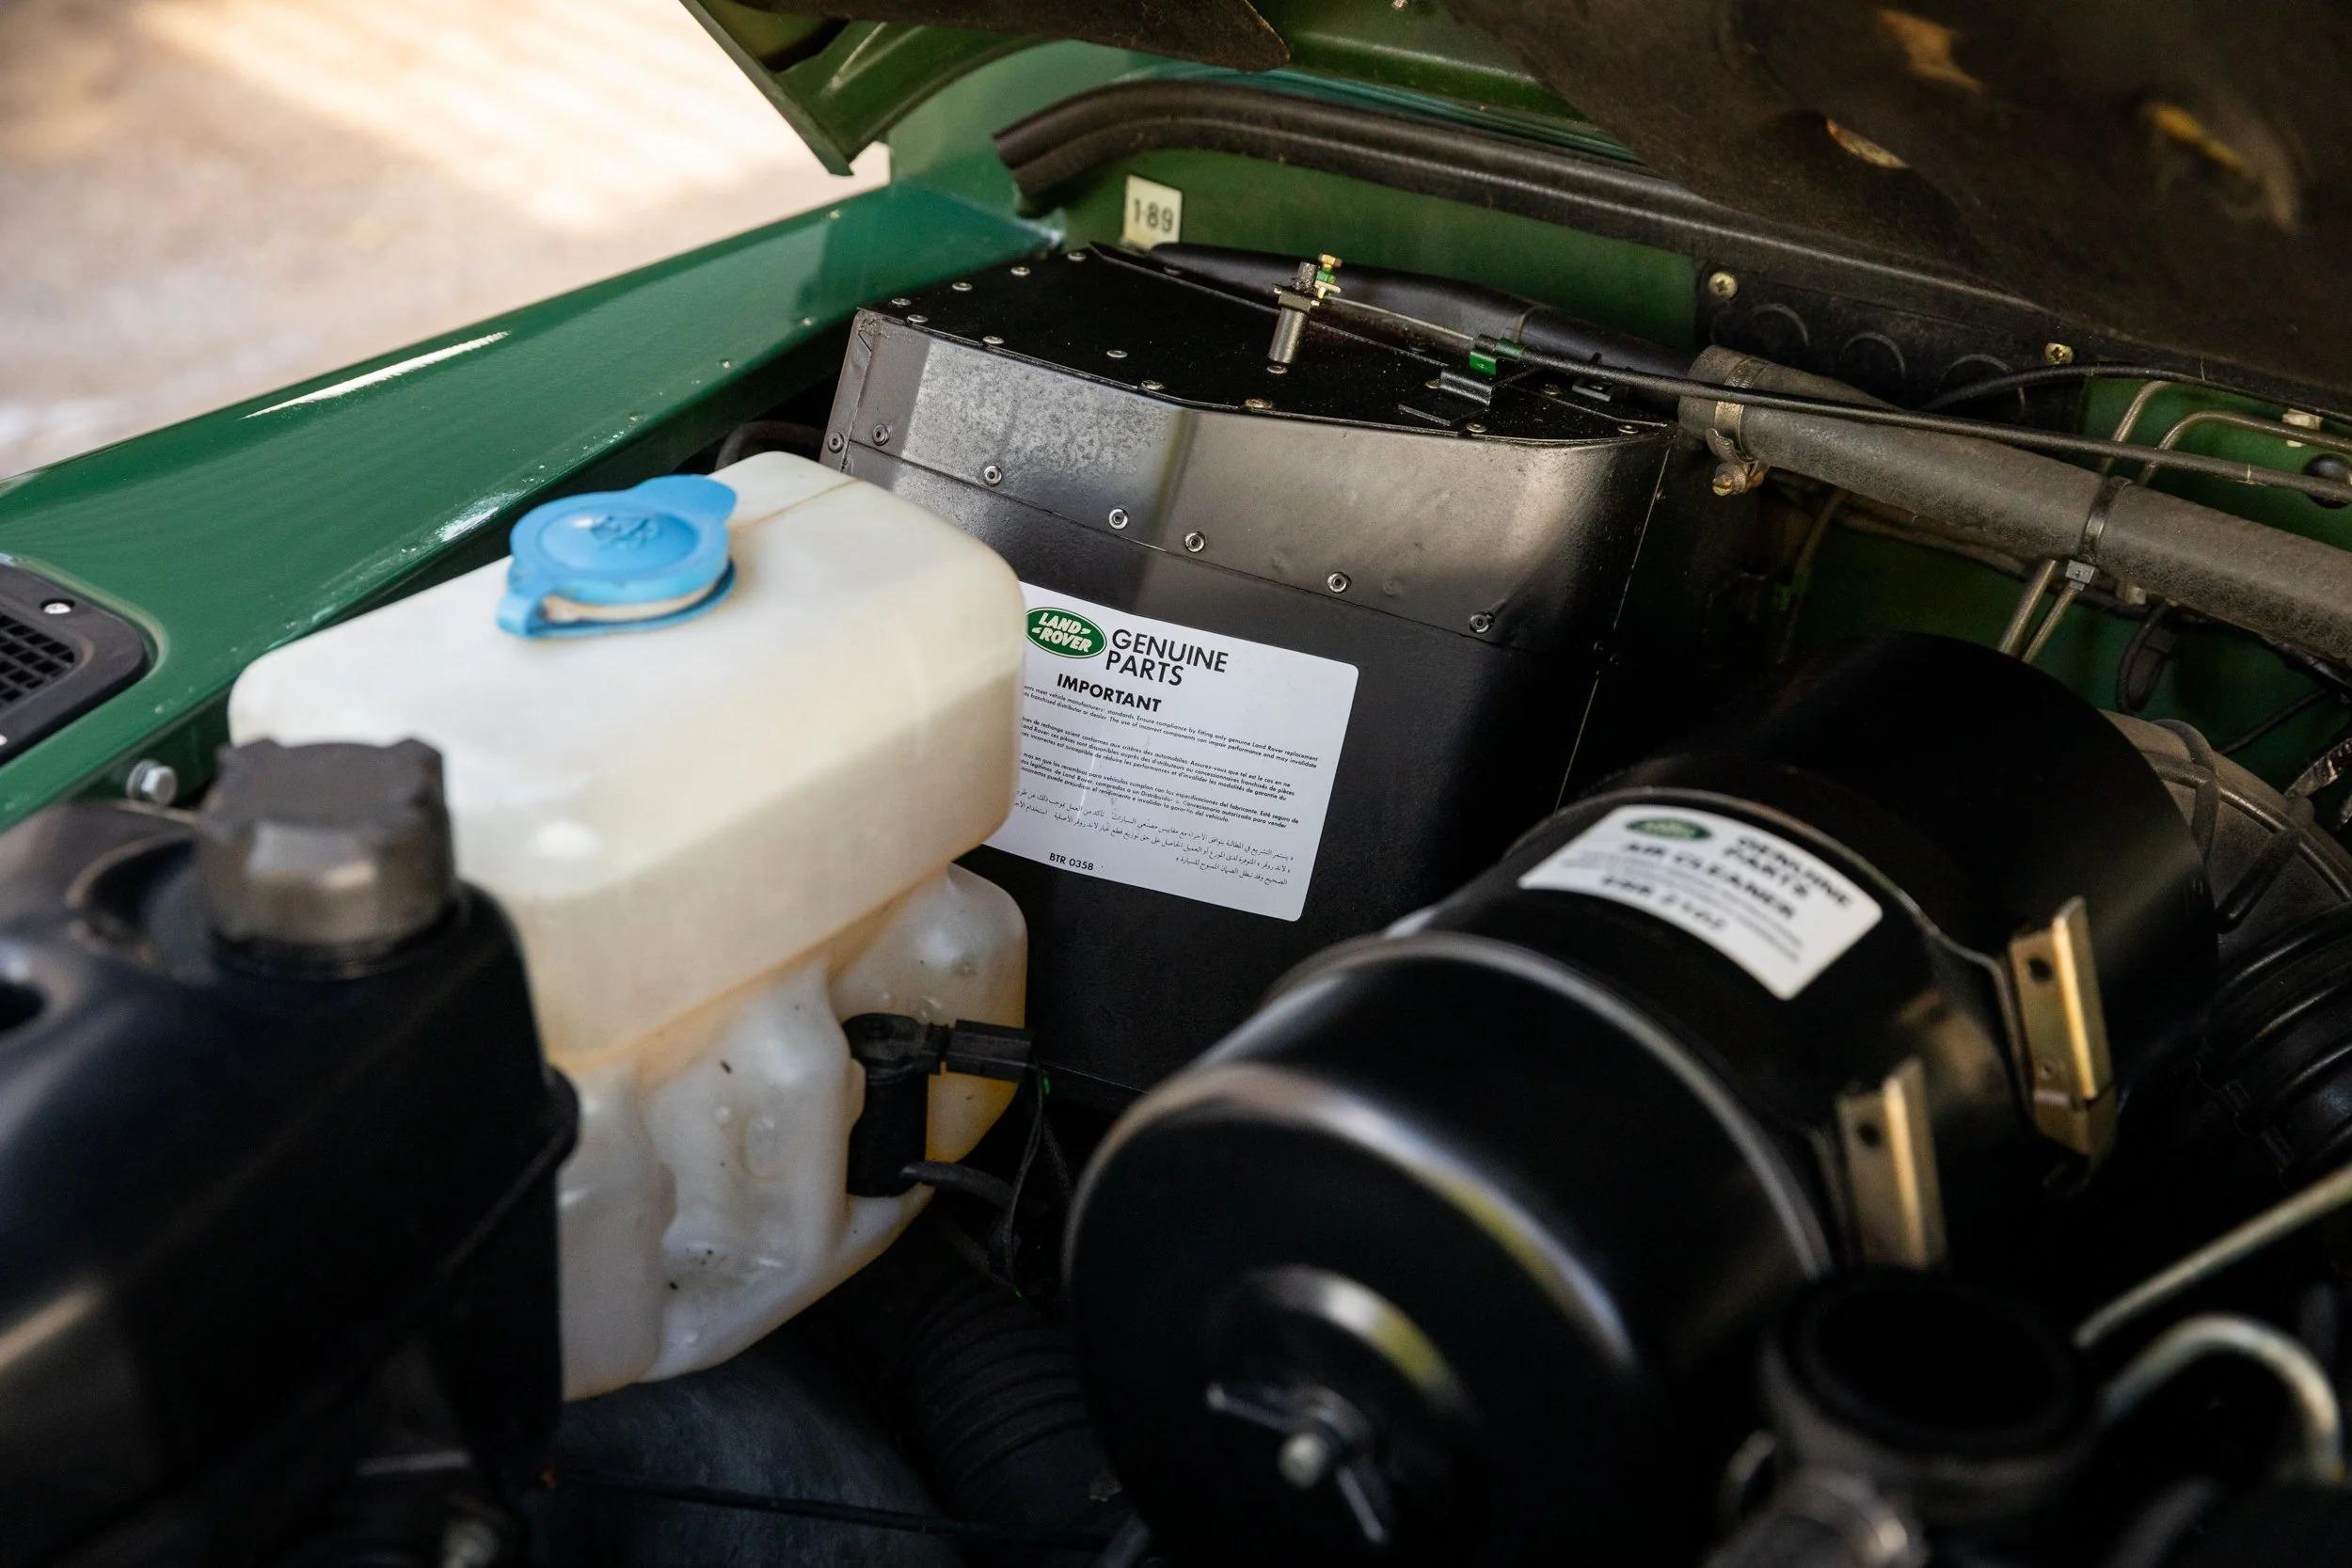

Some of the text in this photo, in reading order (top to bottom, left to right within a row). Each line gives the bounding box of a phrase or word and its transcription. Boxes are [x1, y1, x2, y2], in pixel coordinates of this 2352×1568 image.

[1134, 198, 1174, 233] 189
[1038, 612, 1083, 636] LAND
[1039, 629, 1092, 652] ROVER
[1105, 649, 1184, 686] PARTS
[1112, 628, 1229, 673] GENUINE
[1057, 673, 1162, 712] IMPORTANT
[1030, 692, 1057, 705] franchised
[1057, 702, 1082, 713] distributor
[1138, 722, 1162, 733] incorrect
[1163, 730, 1196, 741] components
[1227, 745, 1262, 756] performance
[1289, 758, 1317, 768] invalidate
[1049, 692, 1066, 702] vehicle
[1136, 715, 1155, 724] Ensure
[1155, 721, 1187, 732] compliance
[1197, 729, 1214, 738] fitting
[1228, 737, 1251, 746] genuine
[1251, 741, 1267, 750] Land
[1267, 745, 1283, 753] Rover
[1284, 751, 1318, 761] replacement
[1081, 736, 1108, 746] conformes
[1062, 771, 1076, 780] Land
[1049, 852, 1094, 871] BTR 0358
